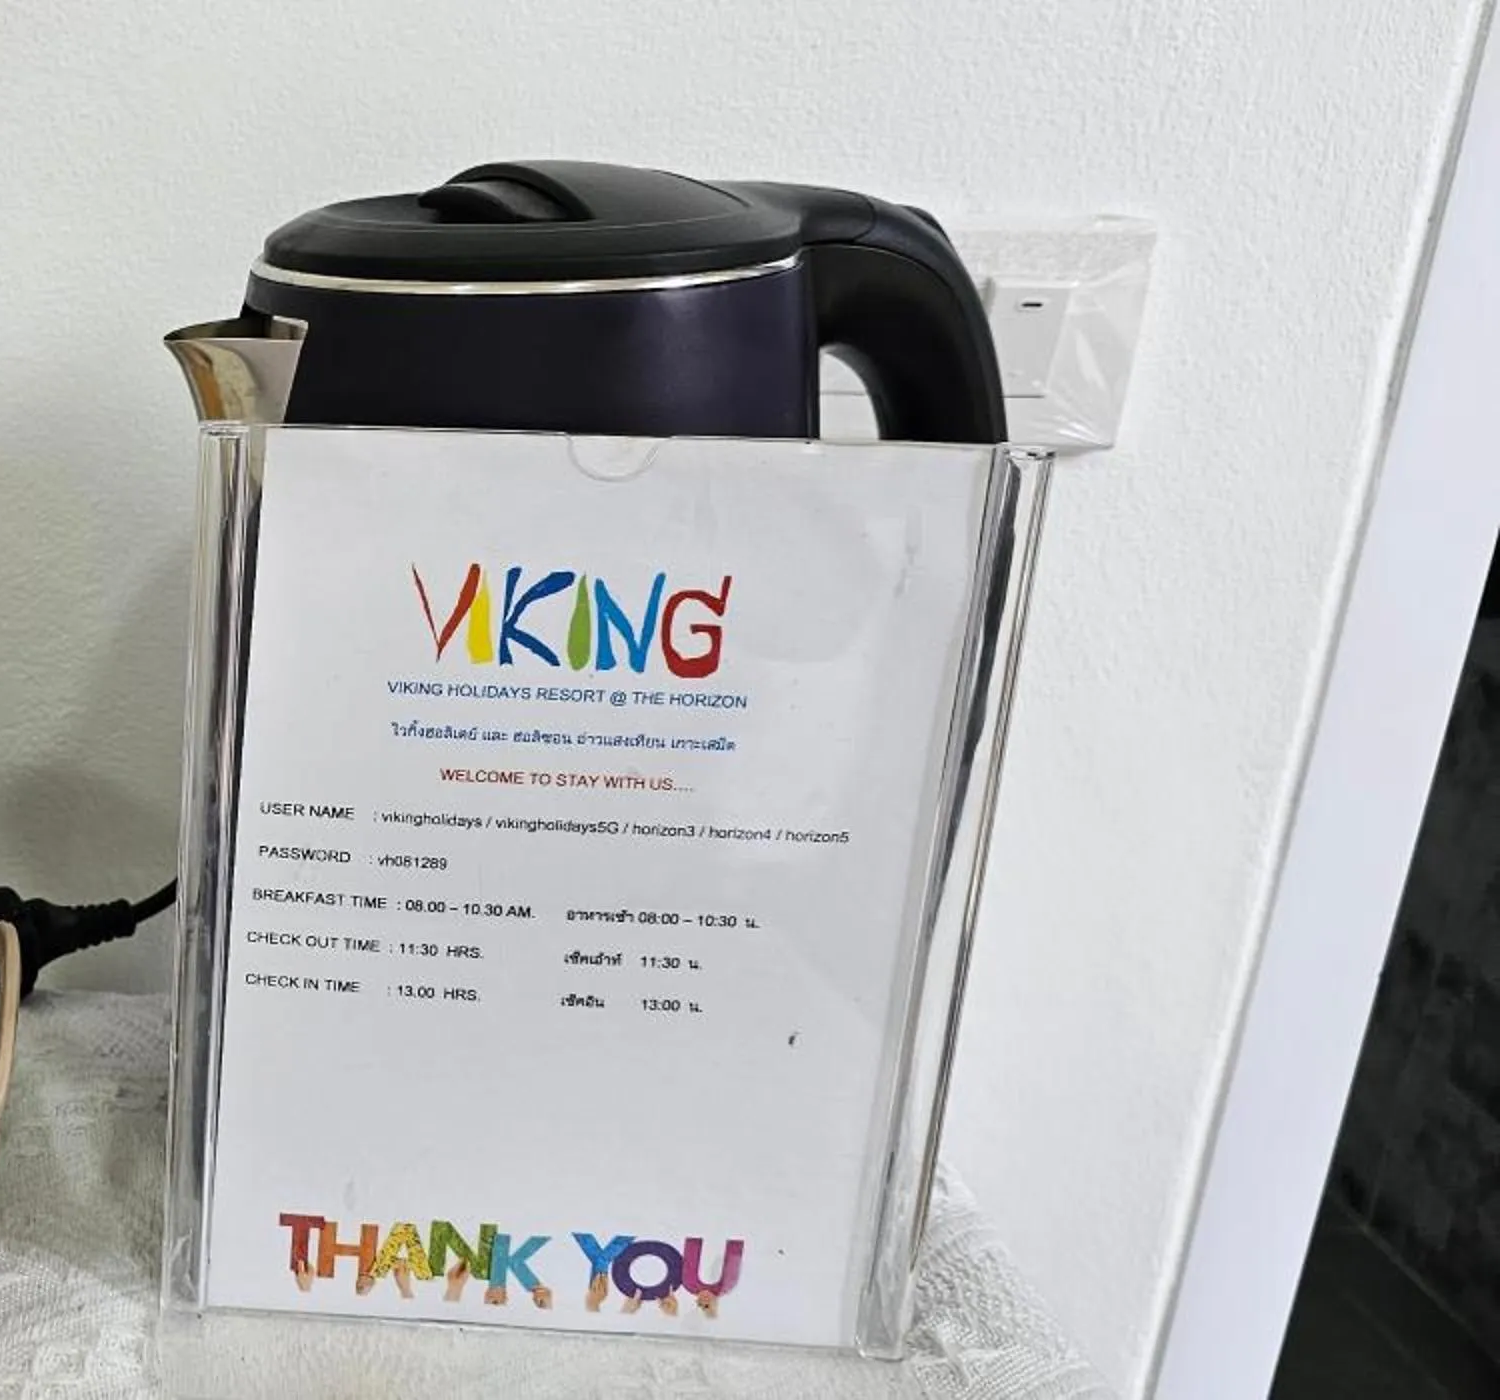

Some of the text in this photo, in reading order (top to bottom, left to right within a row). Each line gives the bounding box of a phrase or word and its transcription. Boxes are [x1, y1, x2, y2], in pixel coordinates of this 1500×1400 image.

[411, 562, 732, 678] VIKING
[387, 681, 748, 709] VIKING HOLIDAYS RESORT @ THE HORIZON
[481, 729, 509, 741] และ
[440, 768, 524, 785] WELCOME
[530, 771, 551, 785] TO
[555, 773, 600, 788] STAY
[603, 775, 646, 789] WITH
[259, 801, 305, 817] USER
[308, 805, 355, 820] NAME
[381, 811, 483, 829] vikingholidays
[495, 817, 619, 836] vikingholidays5G
[632, 823, 696, 838] horizon3
[708, 826, 772, 841] horizon4
[785, 829, 850, 844] horizon5
[258, 845, 352, 864] PASSWORD
[252, 888, 345, 907] BREAKFAST
[351, 896, 388, 910] TIME
[404, 899, 446, 914] 08.00
[462, 902, 503, 917] 10.30
[505, 904, 537, 919] AM.
[637, 911, 680, 926] 08:00
[698, 914, 738, 928] 10:30
[246, 931, 302, 946] CHECK
[305, 934, 339, 949] OUT
[344, 937, 381, 953] TIME
[398, 942, 439, 957] 11:30
[445, 945, 485, 960] HRS.
[639, 955, 681, 969] 11:30
[244, 972, 300, 989] CHECK
[302, 976, 320, 990] IN
[324, 978, 361, 994] TIME
[396, 984, 436, 999] 13.00
[442, 987, 481, 1002] HRS.
[641, 998, 682, 1012] 13:00
[279, 1213, 745, 1301] THANK YOU
